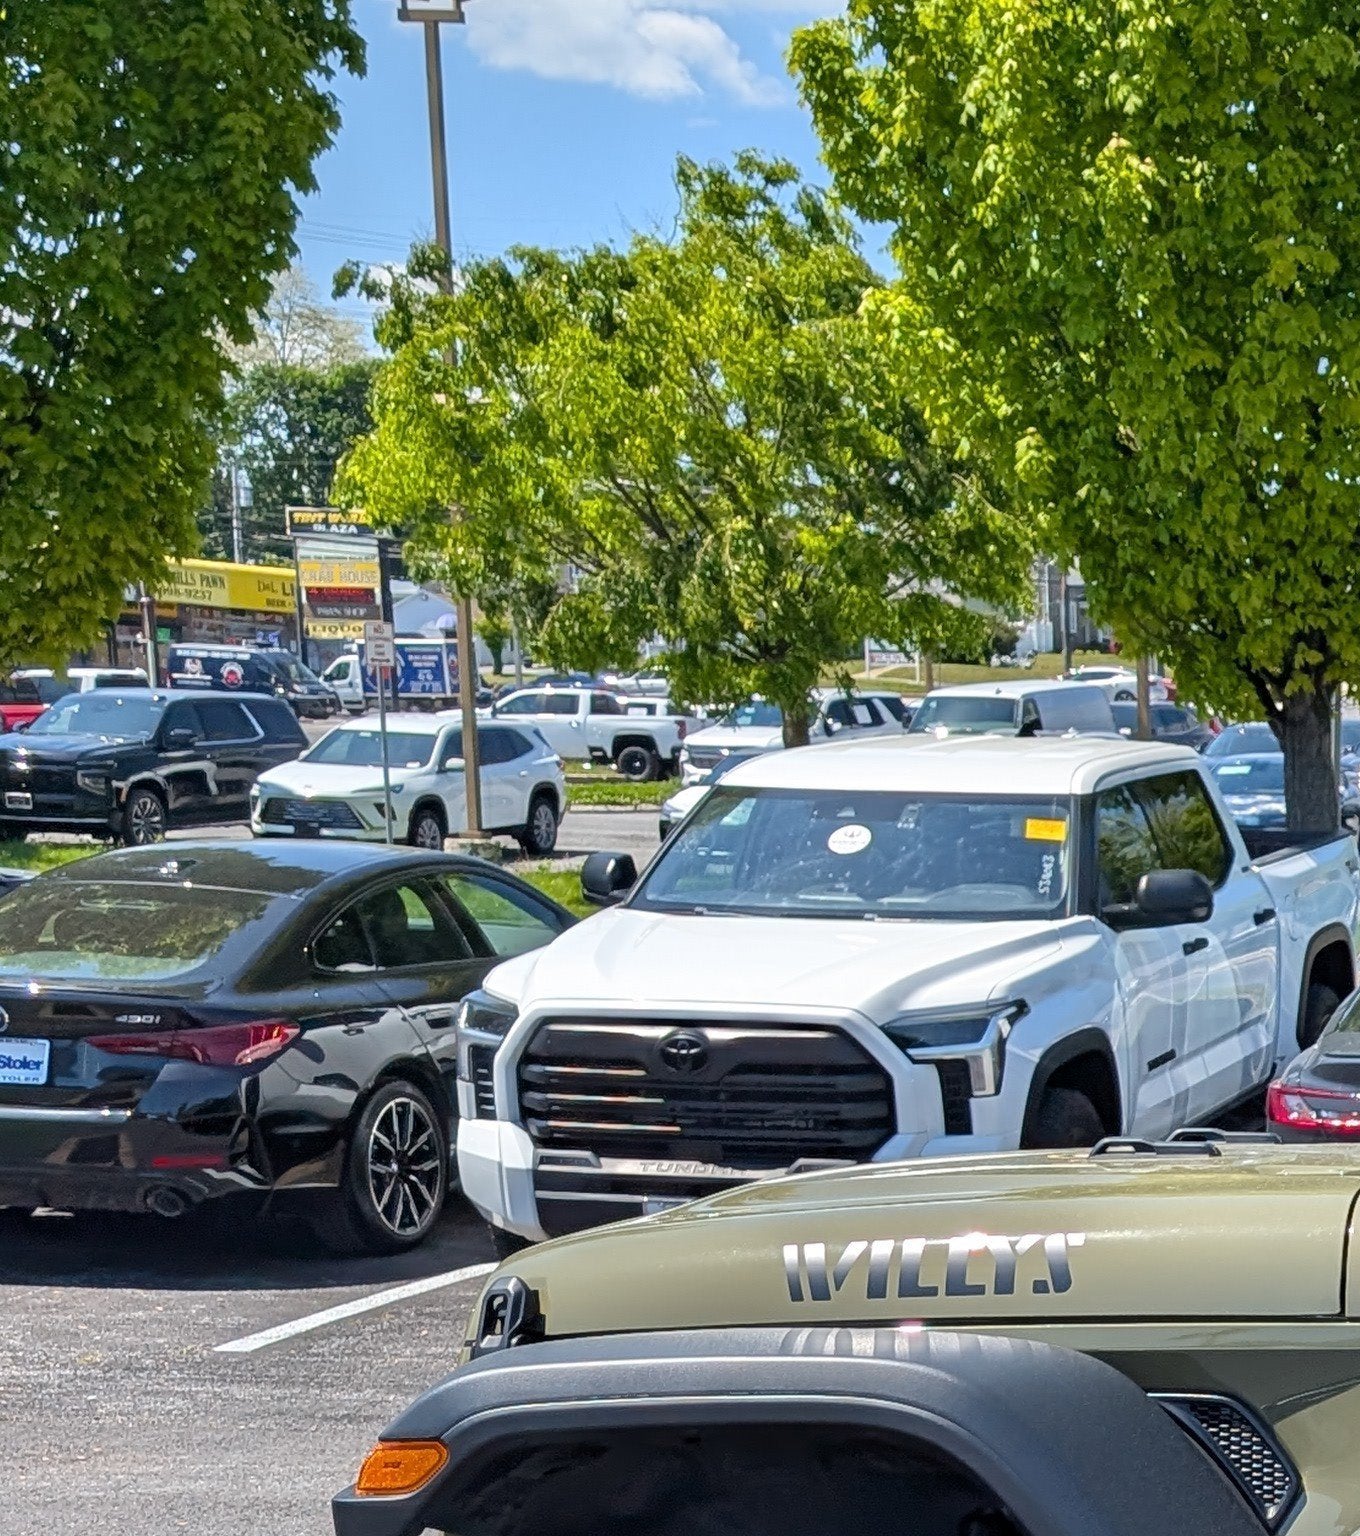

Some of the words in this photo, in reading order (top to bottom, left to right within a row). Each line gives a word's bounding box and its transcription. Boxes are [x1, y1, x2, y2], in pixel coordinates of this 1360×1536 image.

[200, 573, 226, 590] PAWN
[0, 1055, 44, 1070] Stoler
[782, 1232, 1087, 1303] WILLYS
